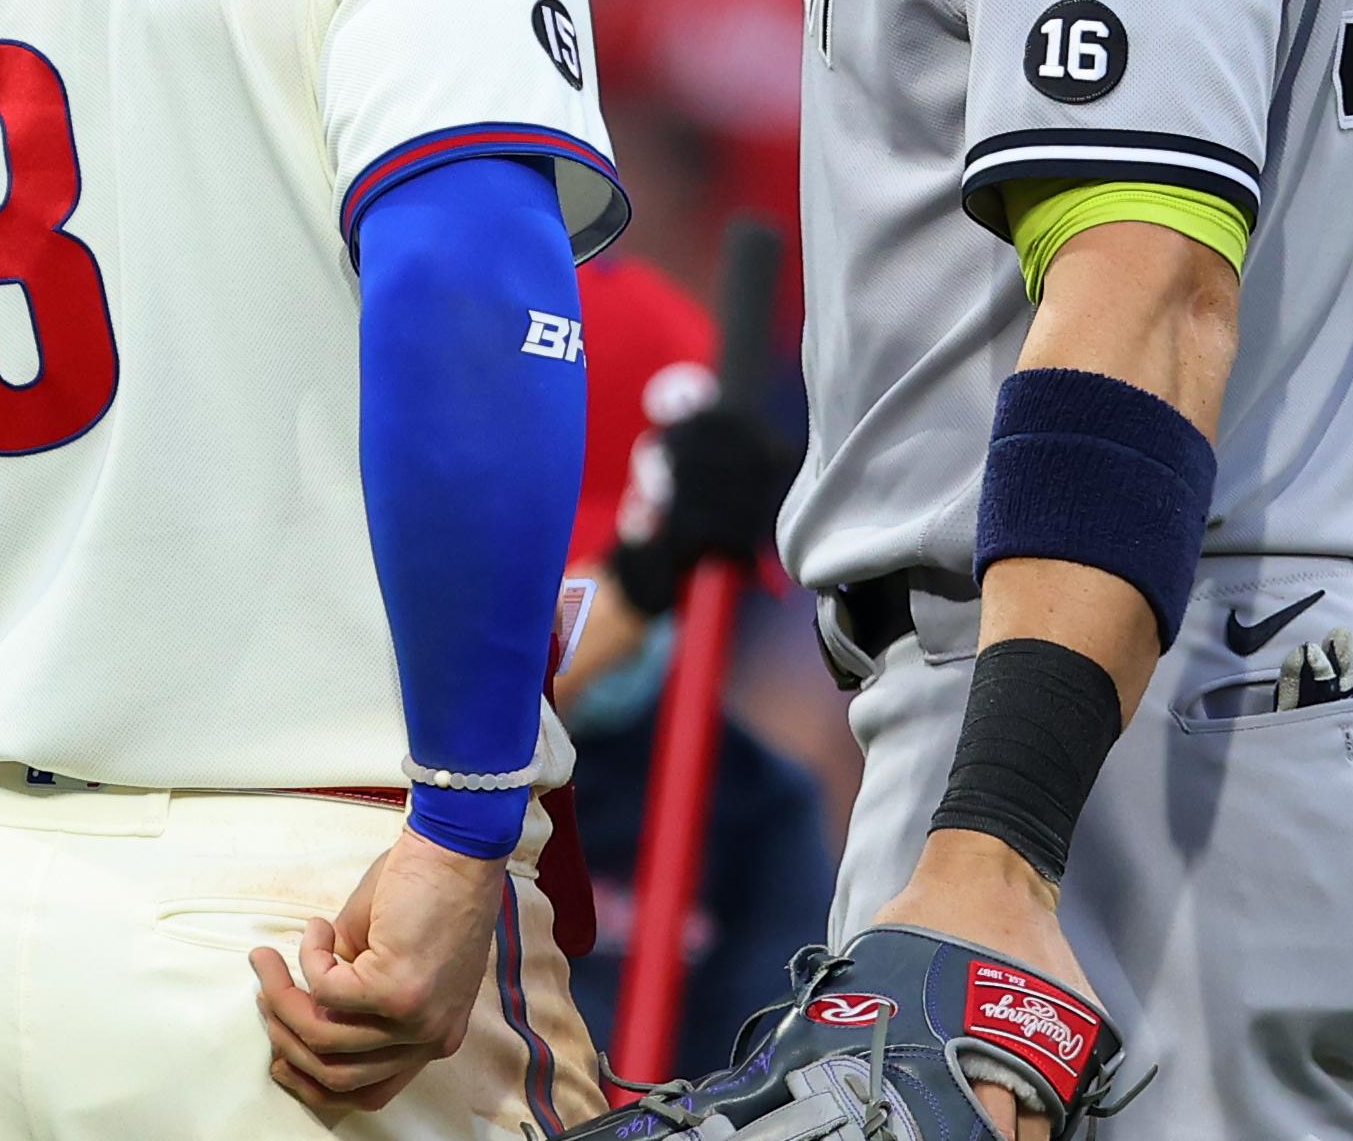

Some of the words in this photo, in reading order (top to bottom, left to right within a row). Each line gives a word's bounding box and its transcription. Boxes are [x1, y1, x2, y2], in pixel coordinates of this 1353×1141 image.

[541, 4, 580, 80] 15
[1037, 18, 1110, 82] 16
[980, 995, 1084, 1061] Rawlings
